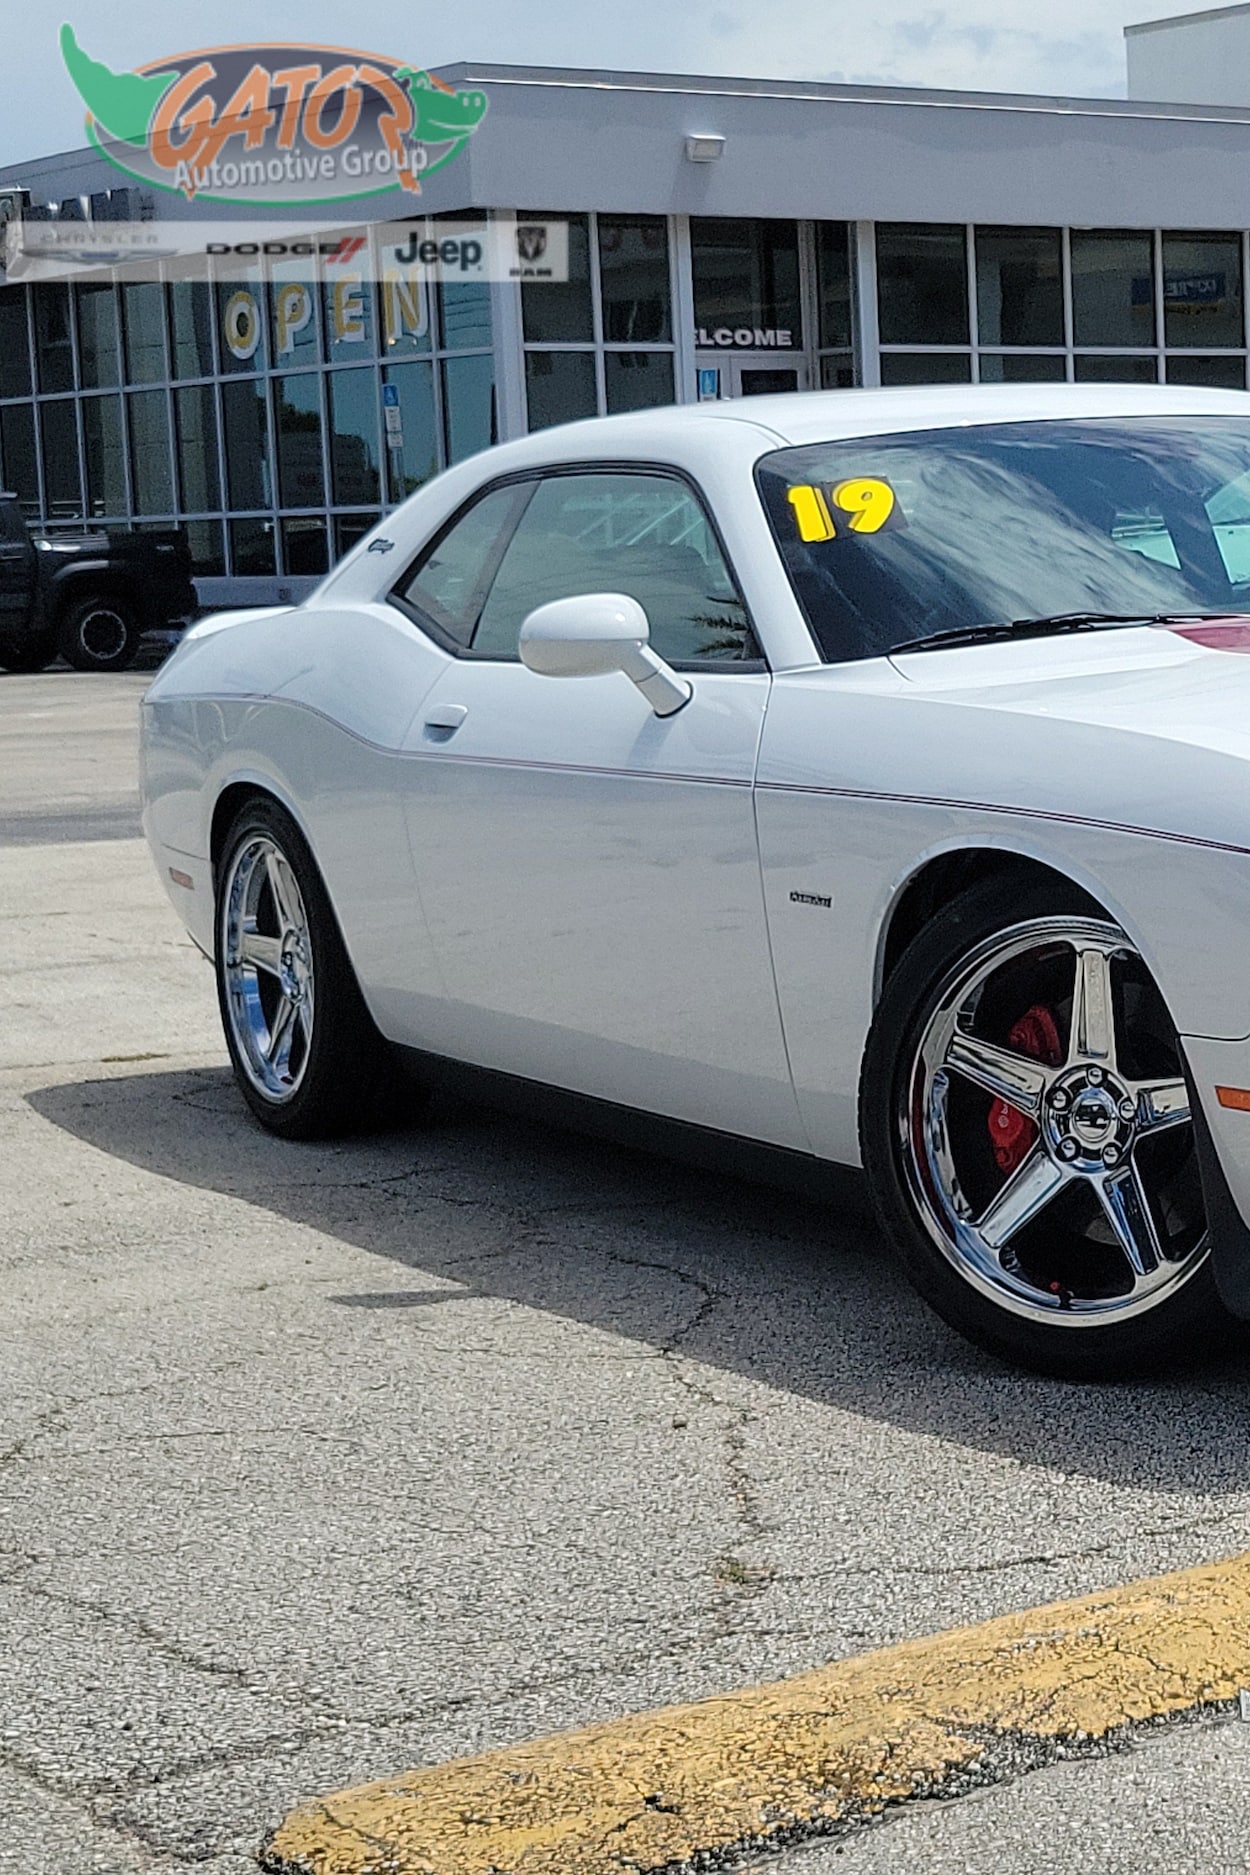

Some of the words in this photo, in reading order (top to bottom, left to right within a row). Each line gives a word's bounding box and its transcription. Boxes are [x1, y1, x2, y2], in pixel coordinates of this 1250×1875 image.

[225, 266, 429, 360] OPEN
[695, 328, 792, 346] LCOME
[788, 478, 895, 543] 19
